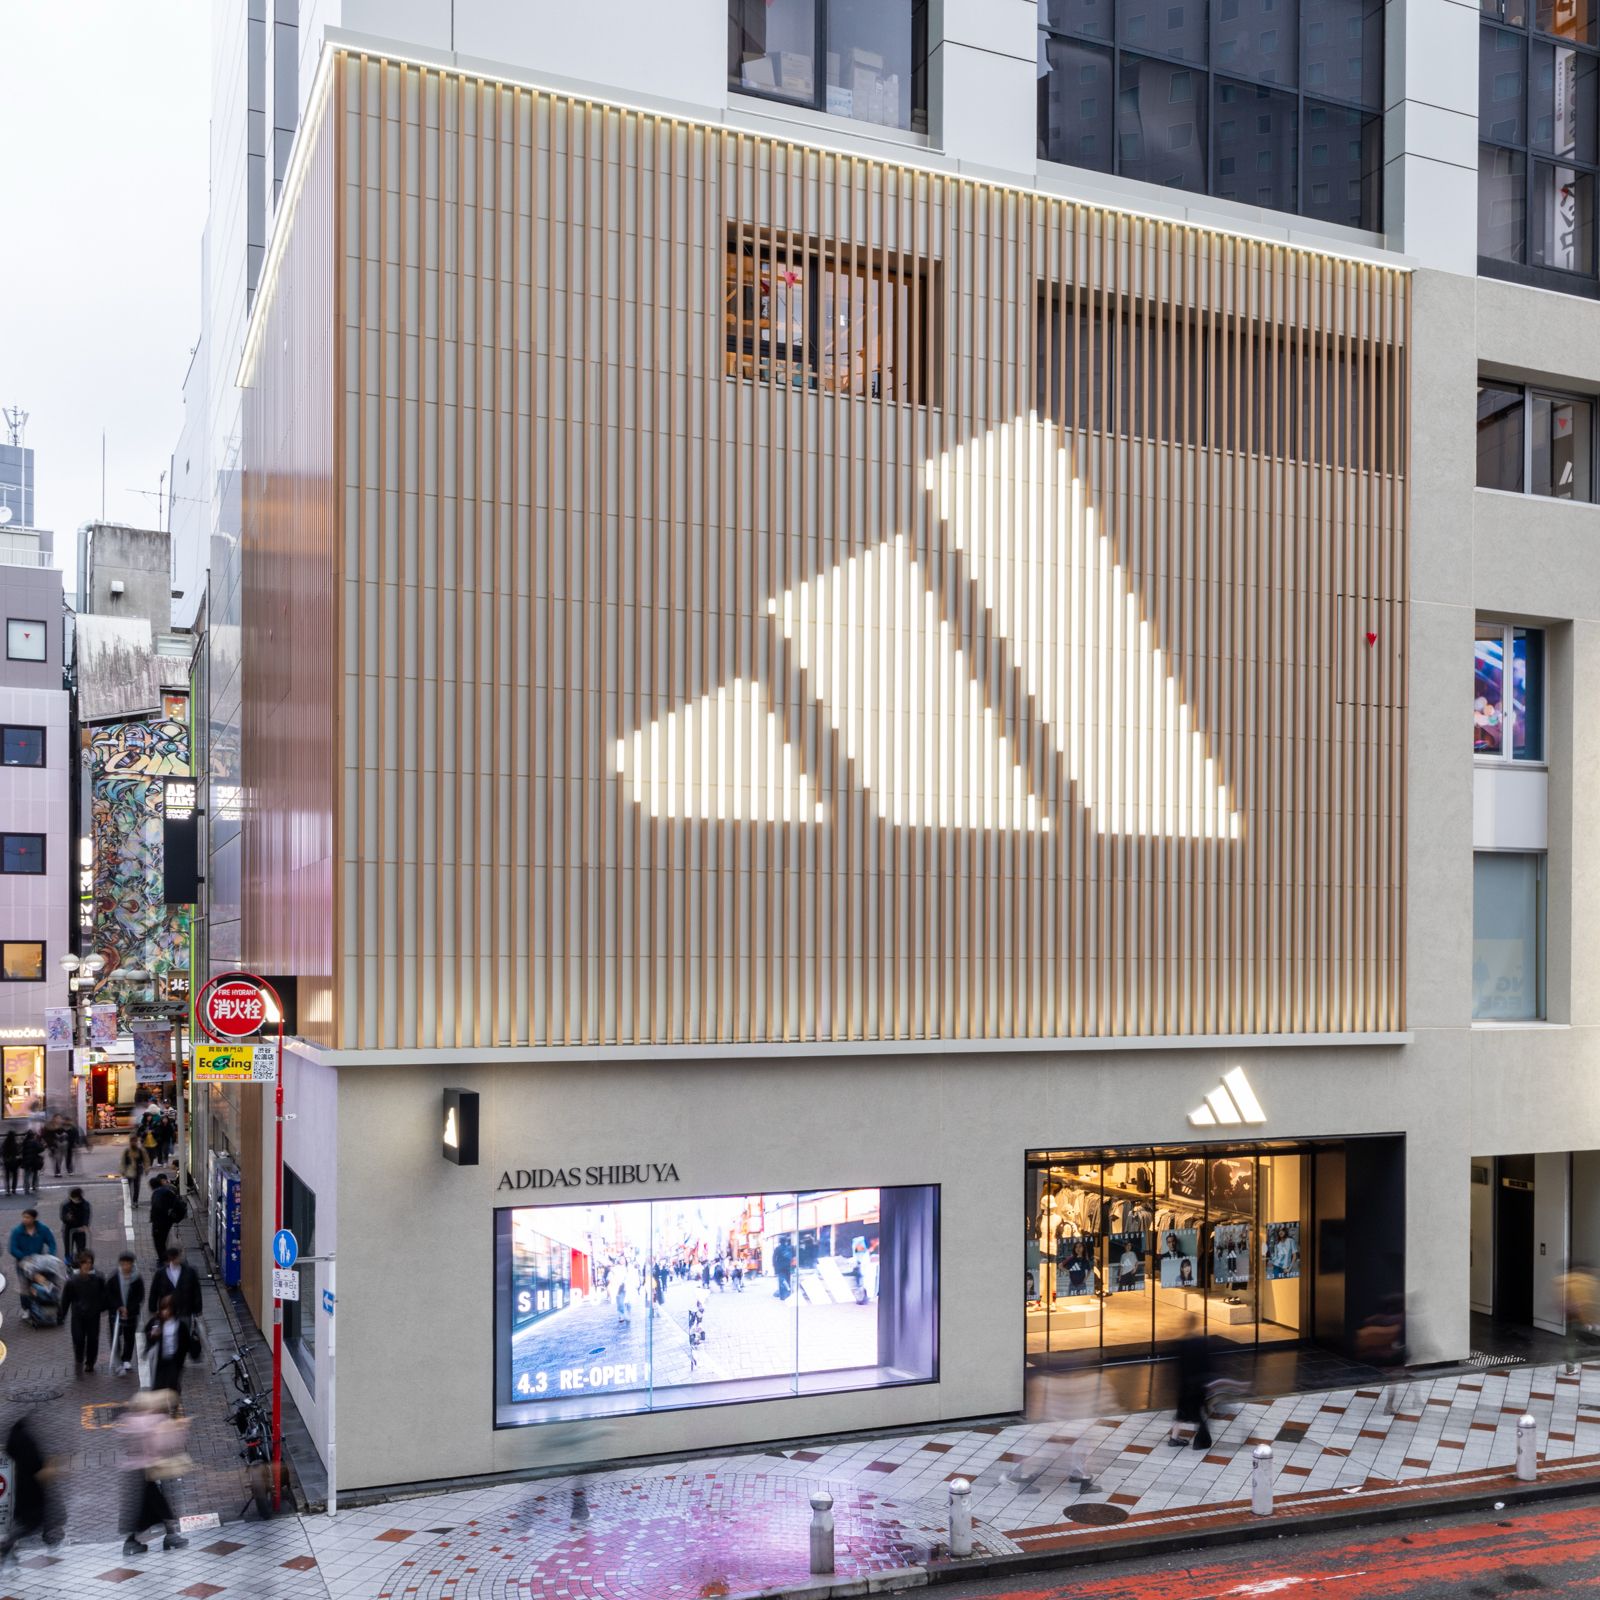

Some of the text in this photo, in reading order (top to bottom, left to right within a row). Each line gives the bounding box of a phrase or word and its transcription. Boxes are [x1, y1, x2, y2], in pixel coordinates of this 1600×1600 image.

[166, 783, 195, 797] ABC
[166, 797, 195, 806] MART
[213, 998, 262, 1019] 消火栓
[497, 1163, 680, 1190] ADIDAS SHIBUYA
[517, 1371, 548, 1394] 4.3
[560, 1363, 637, 1390] RE-OPEN
